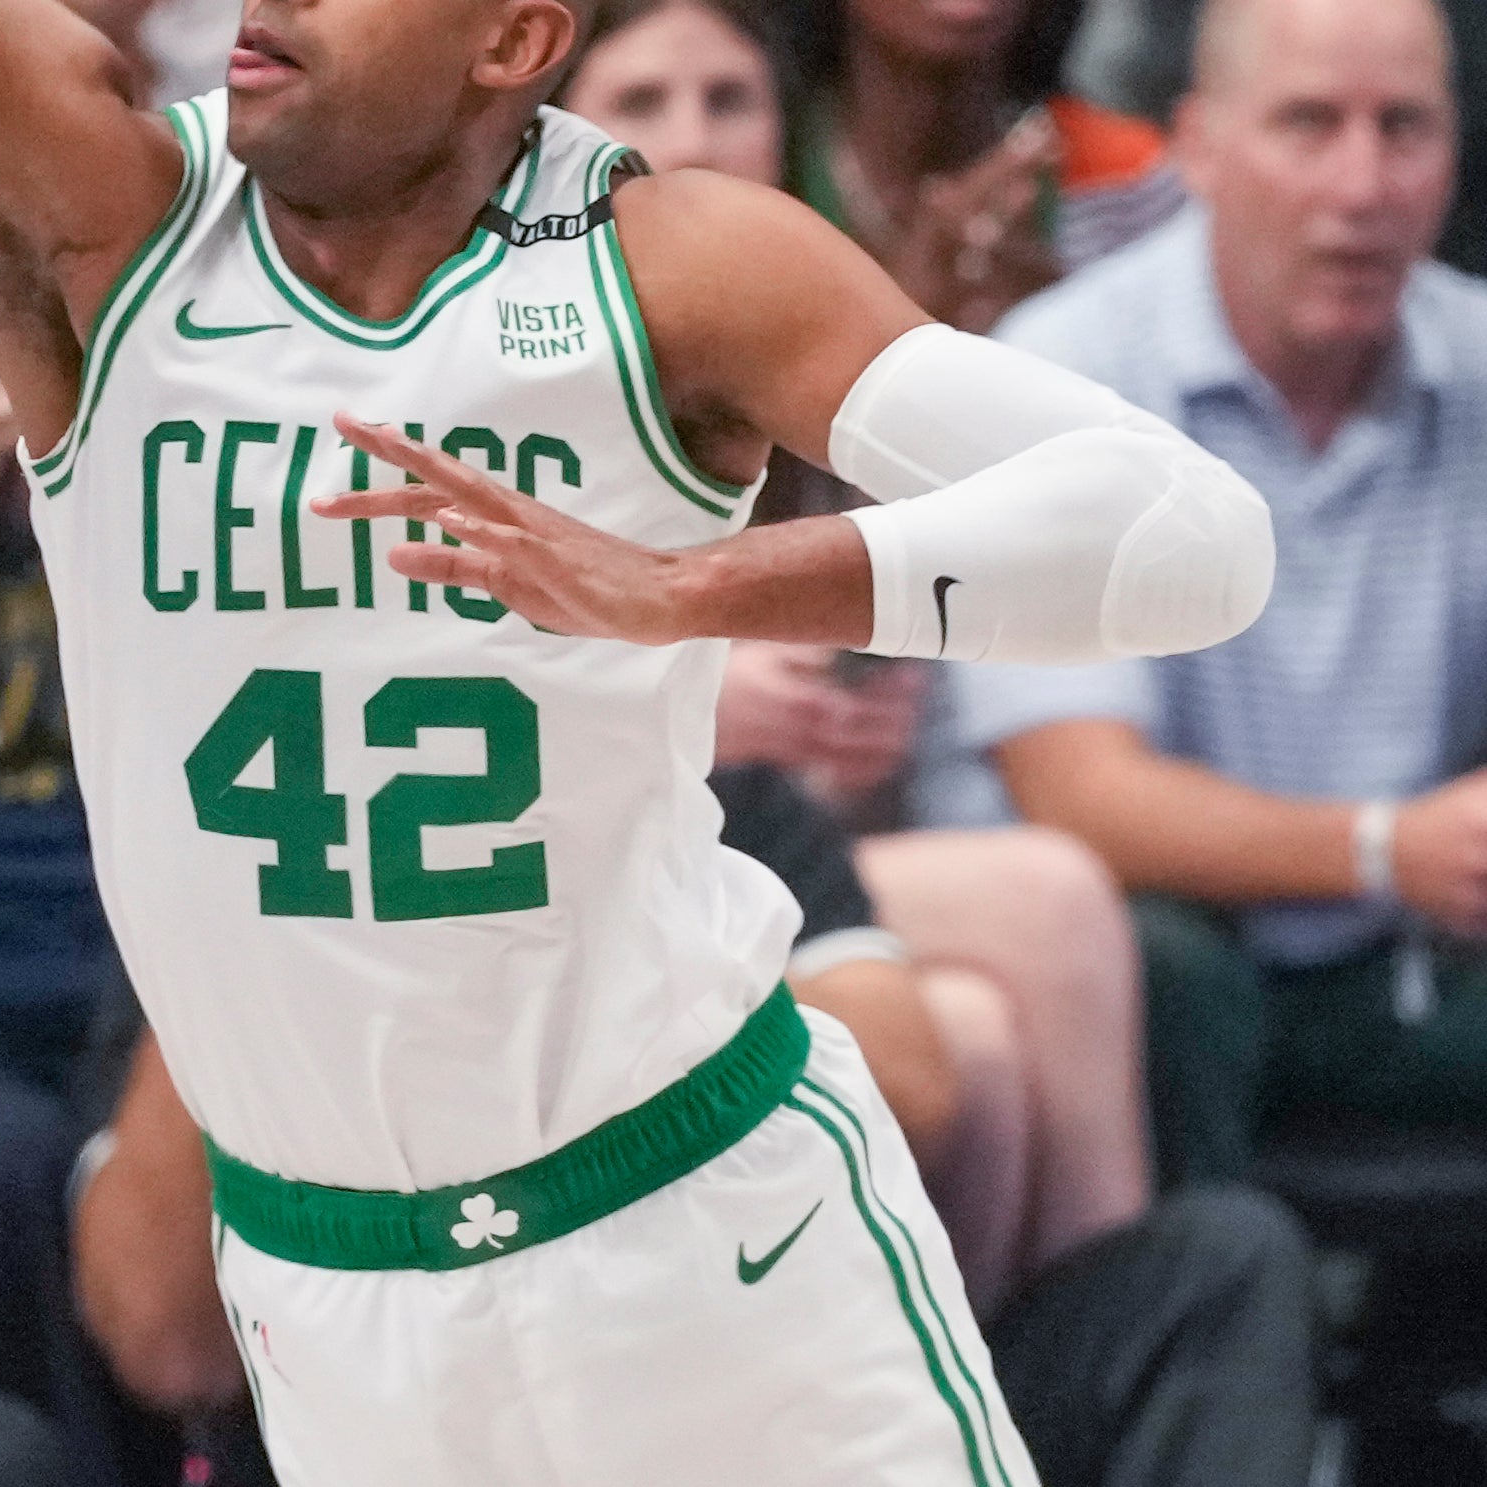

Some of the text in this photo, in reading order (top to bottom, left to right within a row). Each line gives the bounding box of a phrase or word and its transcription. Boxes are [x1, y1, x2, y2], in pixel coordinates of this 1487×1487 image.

[497, 298, 584, 332] VISTA
[500, 329, 586, 360] PRINT
[183, 668, 551, 923] 42
